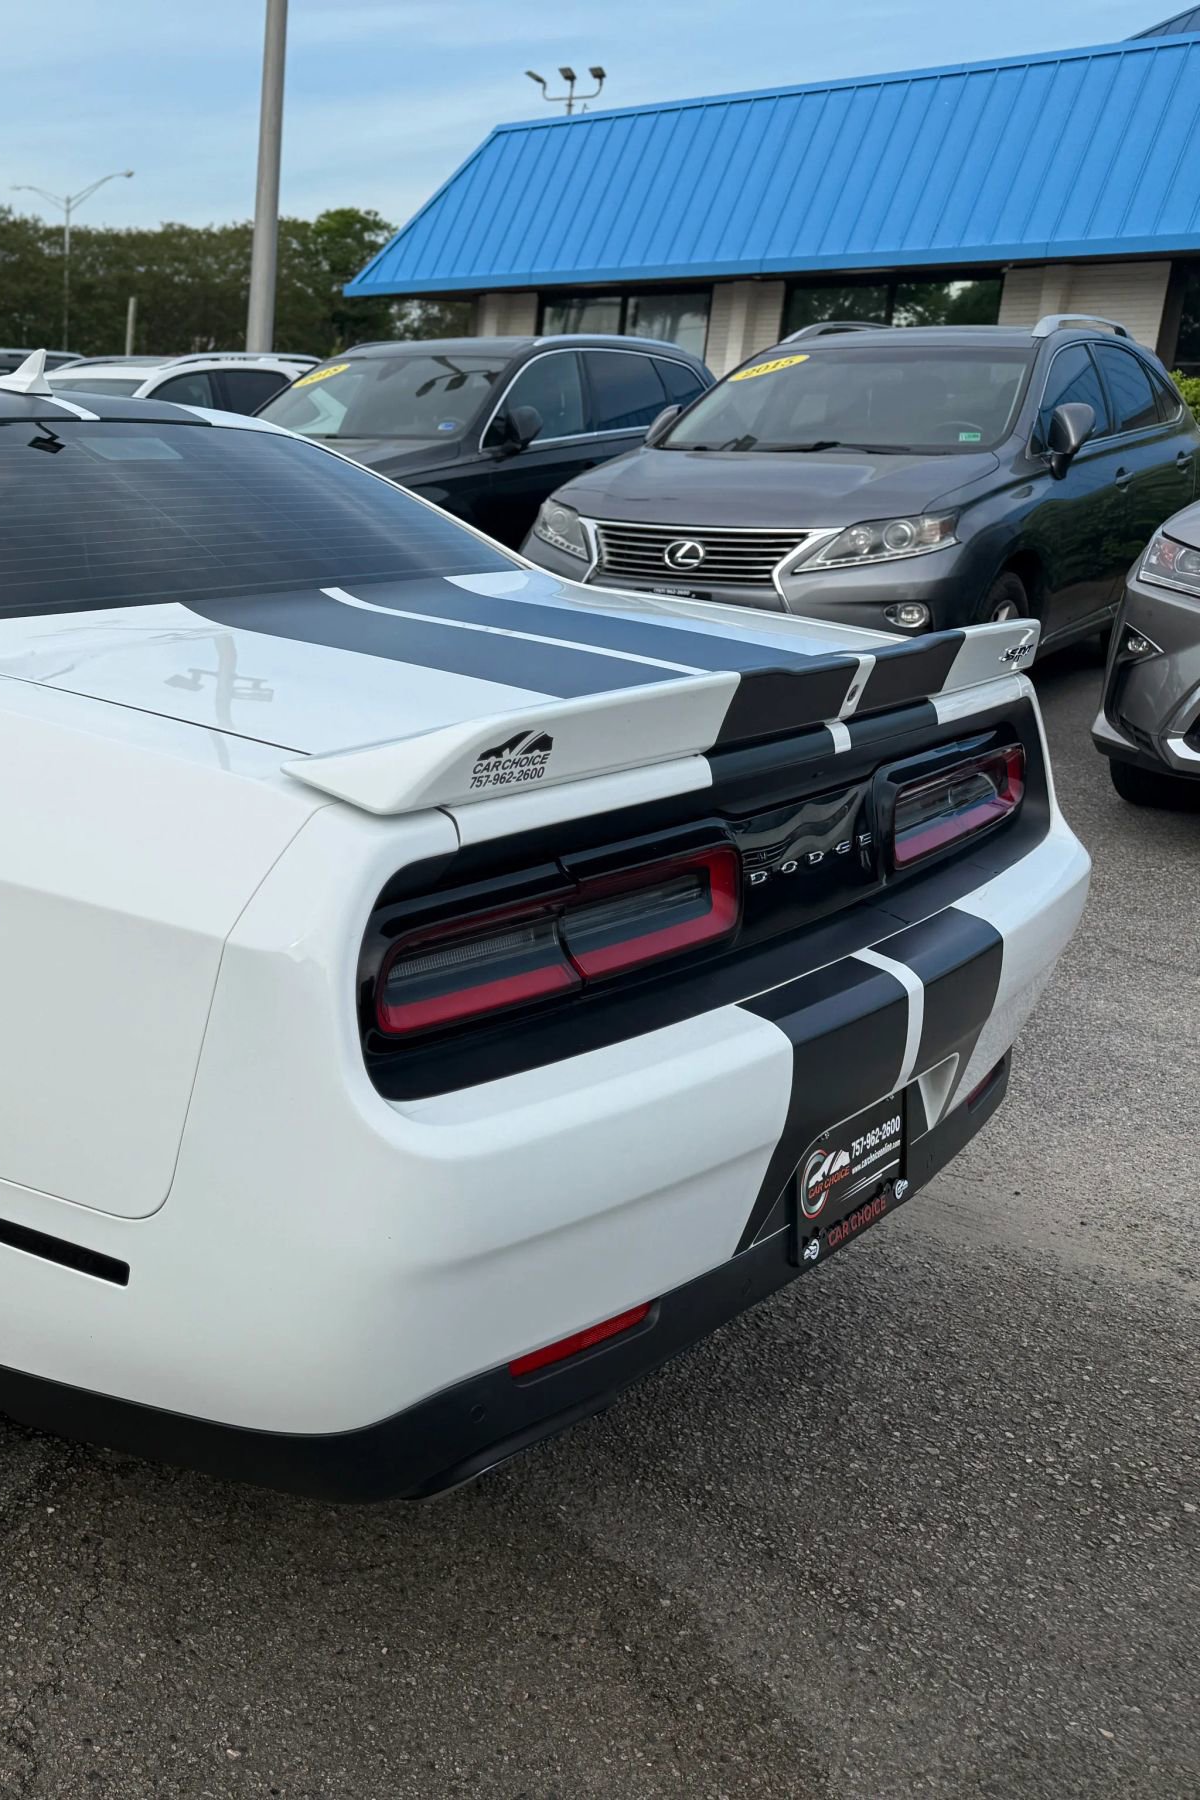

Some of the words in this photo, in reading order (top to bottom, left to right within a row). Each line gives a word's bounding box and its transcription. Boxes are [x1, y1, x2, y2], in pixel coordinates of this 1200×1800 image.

[469, 766, 546, 789] 757-962-2600
[750, 832, 873, 886] DODGE
[851, 1114, 901, 1160] 757-962-2600
[808, 1182, 824, 1199] CAR
[824, 1166, 850, 1188] CHOICE
[828, 1219, 849, 1247] CAR
[850, 1194, 887, 1228] CHOICE
